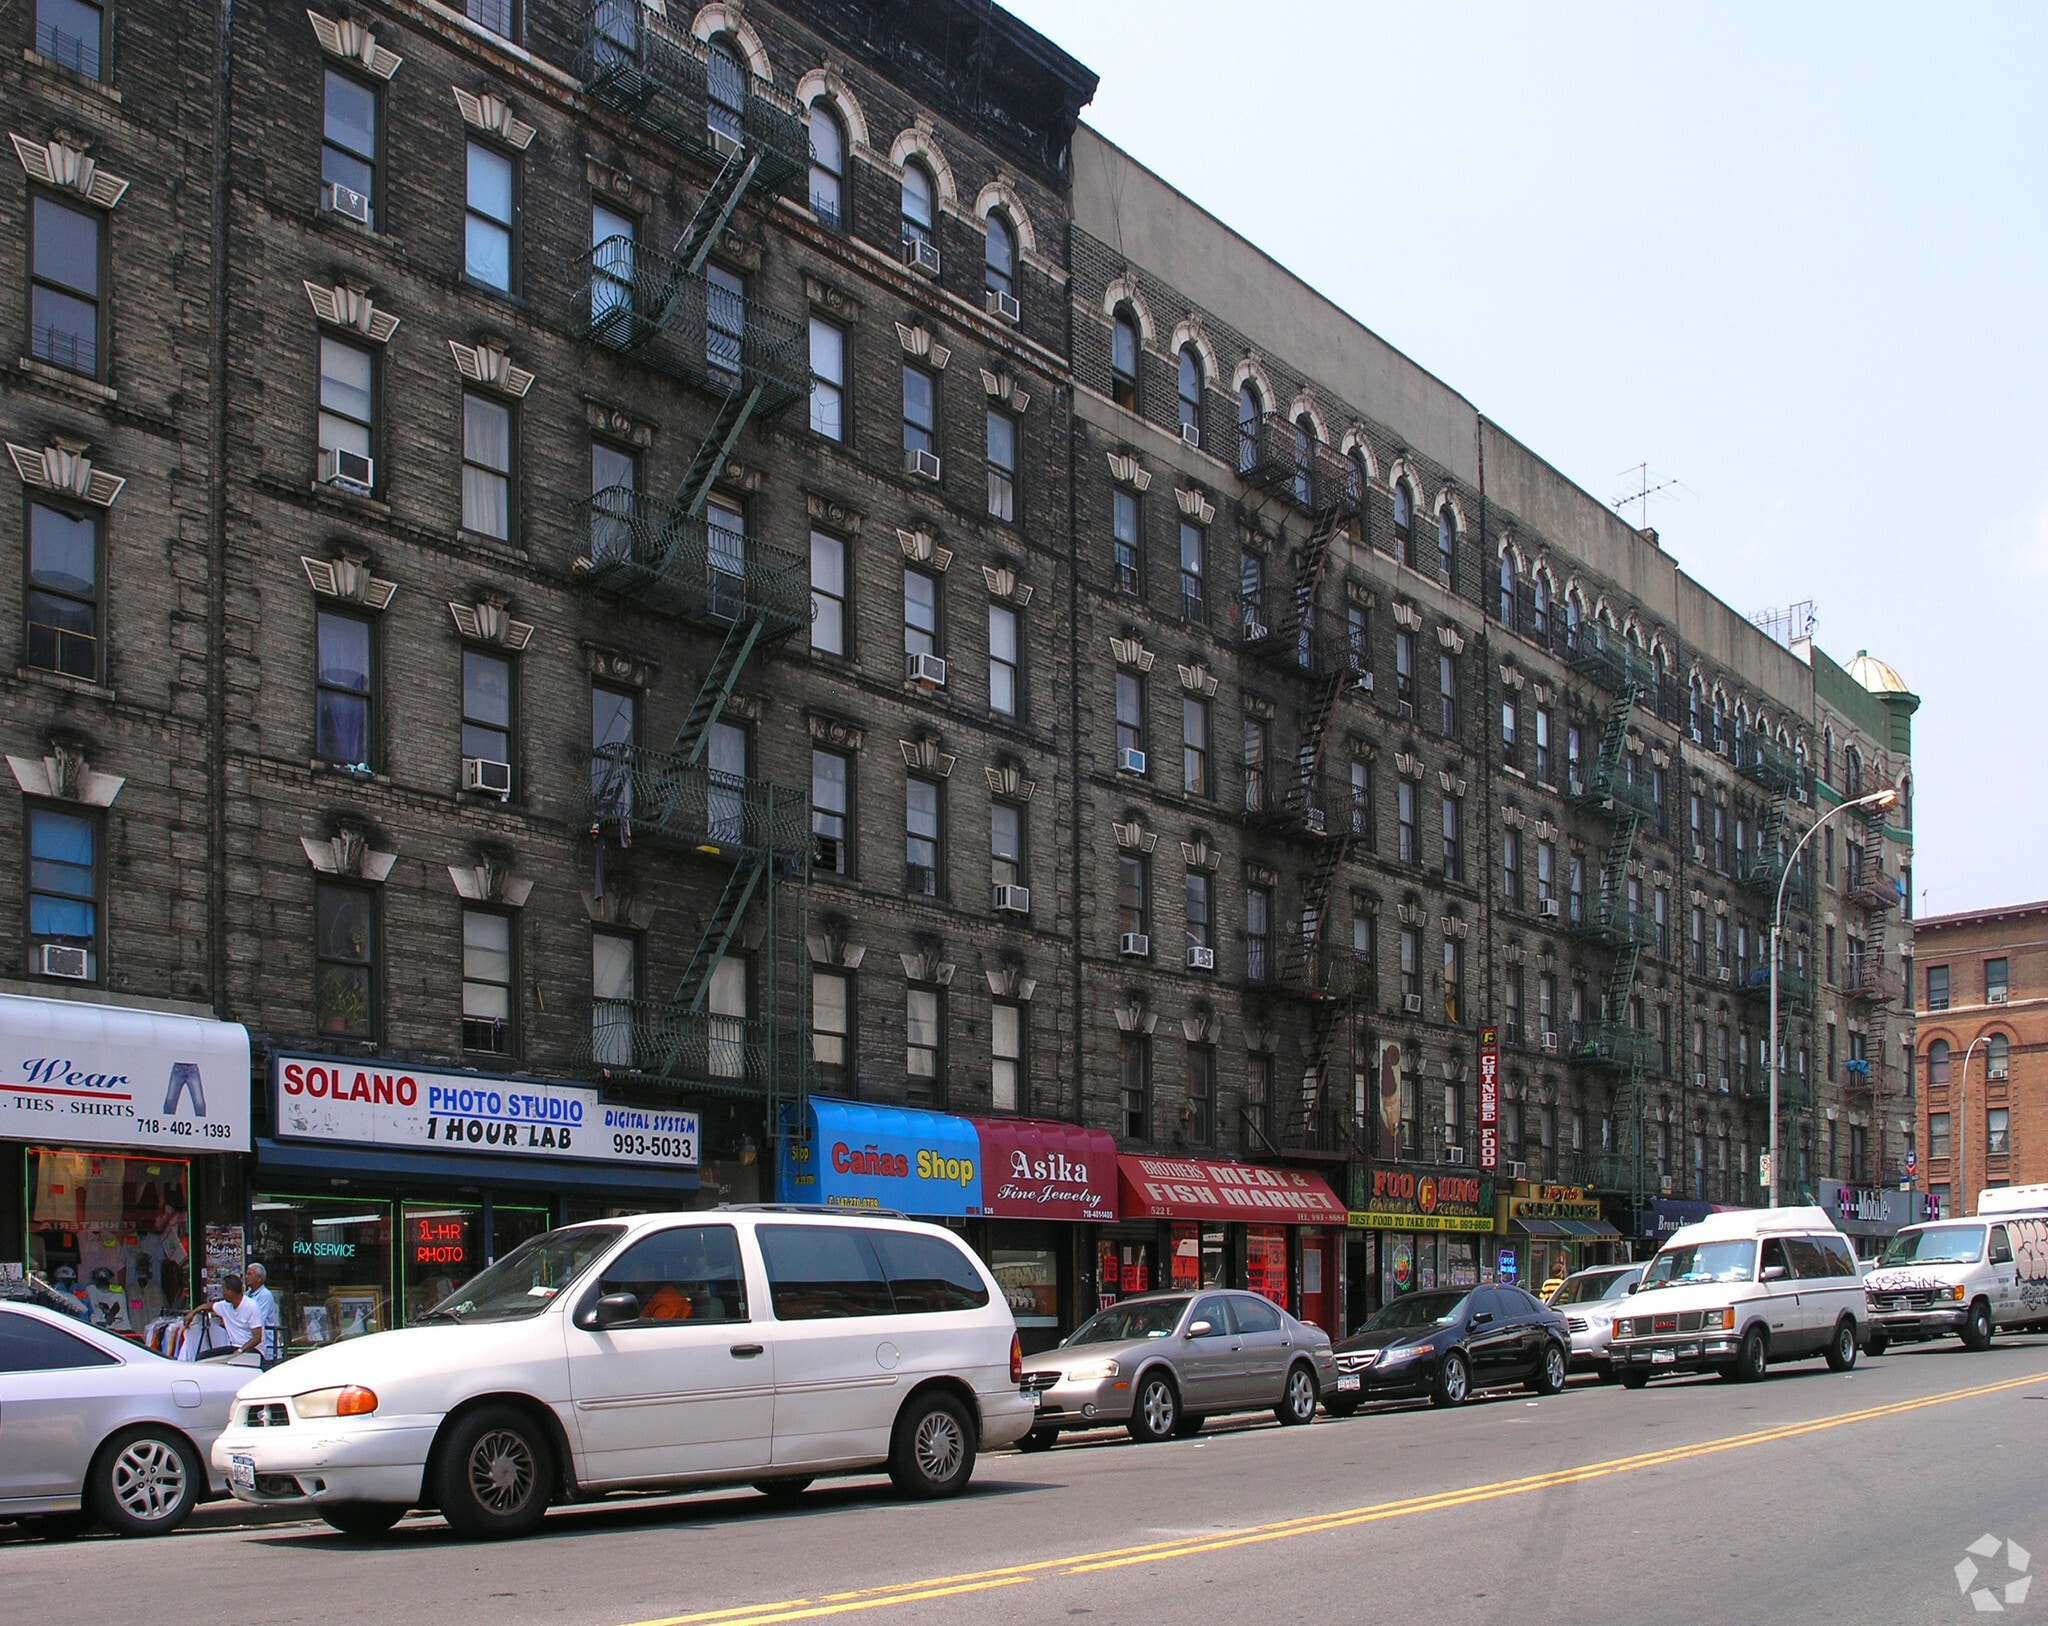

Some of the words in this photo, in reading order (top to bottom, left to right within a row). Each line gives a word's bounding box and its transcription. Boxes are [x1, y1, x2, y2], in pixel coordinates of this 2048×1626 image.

[22, 1058, 130, 1089] Wear
[284, 1064, 418, 1106] SOLANO
[1482, 1055, 1495, 1121] CHINESE
[14, 1096, 54, 1112] TIES
[70, 1101, 135, 1118] SHIRTS
[429, 1086, 500, 1115] PHOTO
[508, 1094, 583, 1122] STUDIO
[427, 1116, 438, 1140] 1
[446, 1118, 518, 1146] HOUR
[528, 1125, 572, 1150] LAB
[604, 1110, 650, 1130] DIGITAL
[653, 1115, 695, 1134] SYSTEM
[613, 1133, 692, 1158] 993-5033
[1482, 1128, 1495, 1166] FOOD
[831, 1141, 909, 1178] Cañas
[916, 1149, 974, 1188] Shop
[1010, 1149, 1089, 1183] Asika
[1139, 1160, 1206, 1179] BROTHERS
[1207, 1166, 1289, 1187] MEAT
[1290, 1172, 1309, 1187] &
[997, 1183, 1037, 1200] Fine
[1037, 1184, 1102, 1208] Jewelry
[1144, 1183, 1219, 1204] FISH
[1219, 1188, 1333, 1209] MARKET
[1373, 1171, 1415, 1199] FOO
[1150, 1206, 1165, 1216] 522
[1373, 1215, 1392, 1227] FOOD
[1395, 1216, 1404, 1227] TO
[1406, 1217, 1425, 1228] TAKE
[1426, 1217, 1440, 1228] OUT
[419, 1219, 461, 1241] 1-HR
[293, 1240, 312, 1255] FAX
[313, 1242, 356, 1257] SERVICE
[417, 1246, 464, 1263] PHOTO
[1656, 1319, 1675, 1328] GMC
